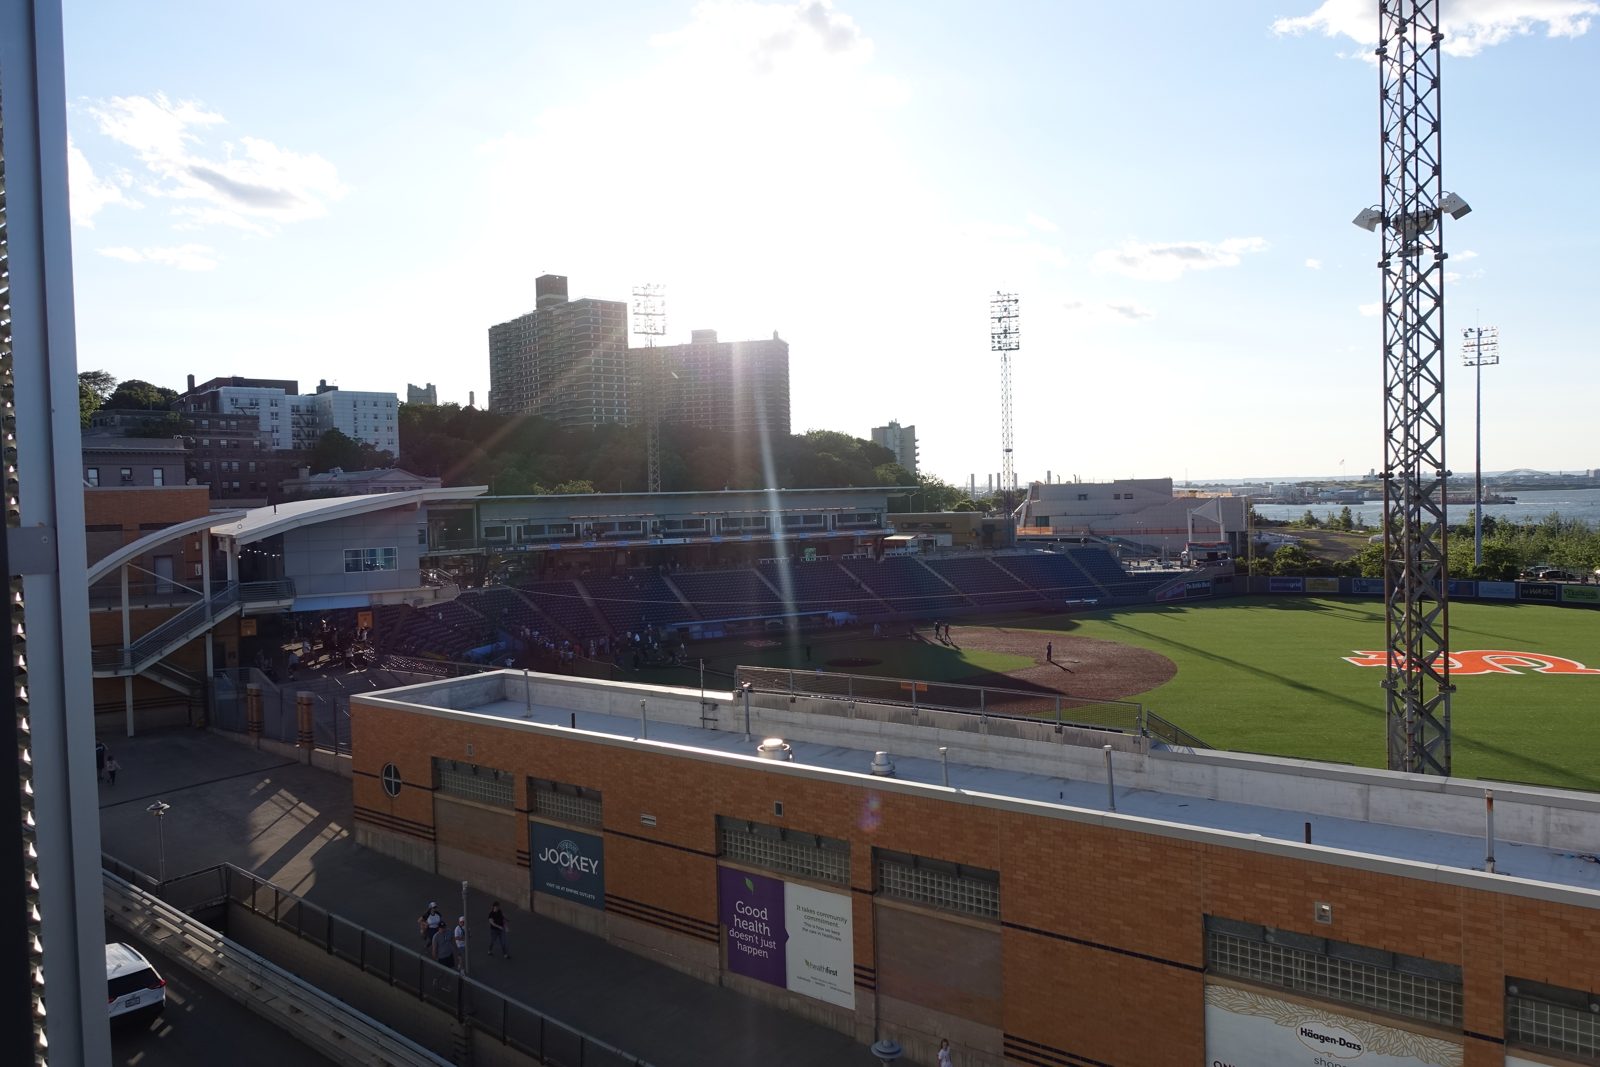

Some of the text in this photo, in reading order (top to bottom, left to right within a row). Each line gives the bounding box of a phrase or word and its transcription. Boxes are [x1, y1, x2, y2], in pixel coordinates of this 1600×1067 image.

[539, 848, 598, 874] JOCKEY
[735, 900, 768, 921] Good
[801, 906, 816, 915] takes
[816, 909, 848, 925] community
[733, 914, 771, 937] health
[729, 928, 777, 950] doesn't just
[737, 941, 769, 959] happen
[1300, 1027, 1362, 1051] Häagen-Dazs
